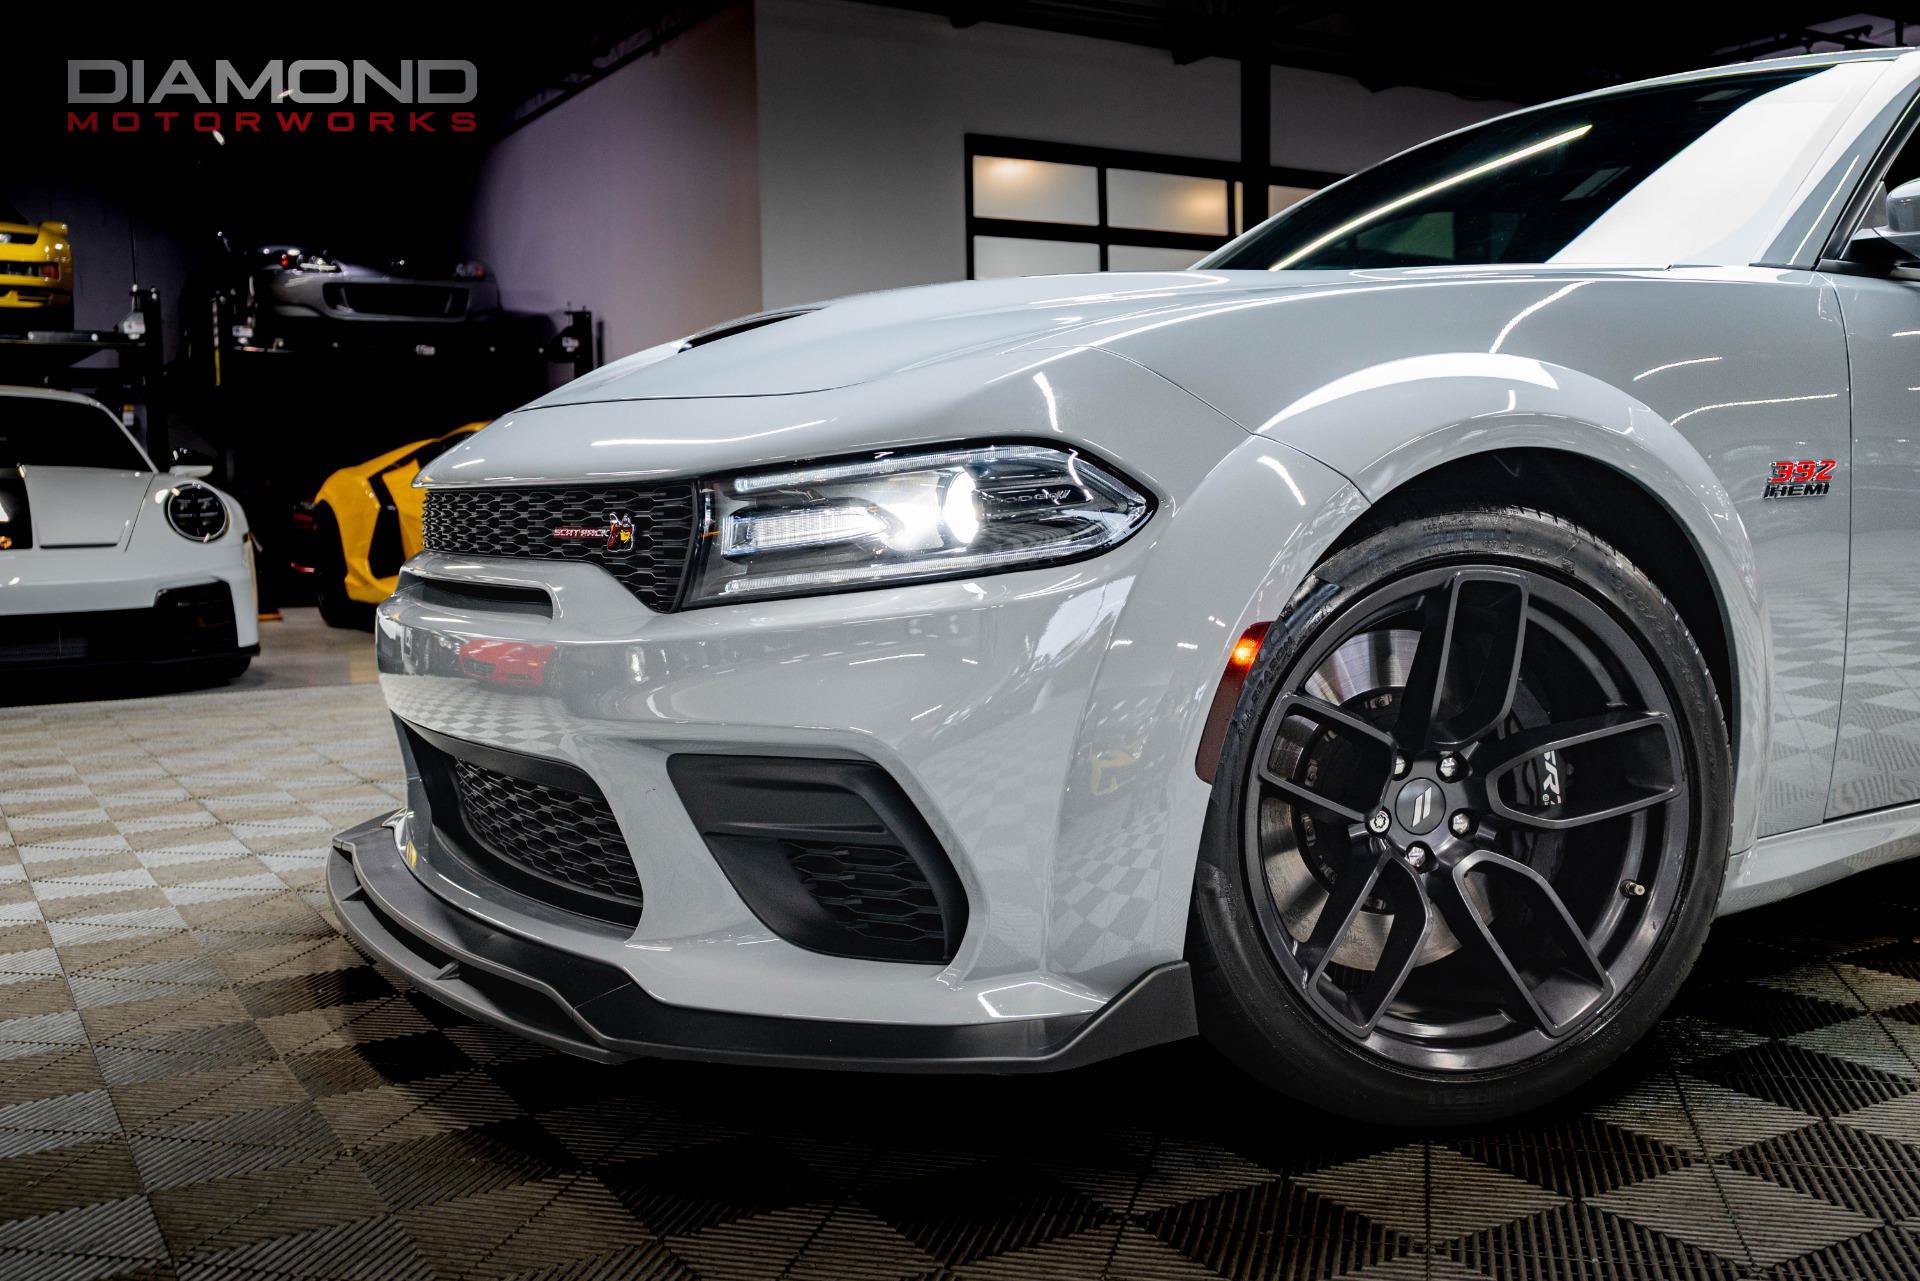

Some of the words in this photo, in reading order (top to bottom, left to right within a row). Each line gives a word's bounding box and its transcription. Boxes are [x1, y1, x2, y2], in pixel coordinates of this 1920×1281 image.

[1767, 459, 1837, 483] 392
[1762, 482, 1830, 499] HEMI
[553, 529, 580, 537] SCAT
[580, 529, 610, 537] PACK
